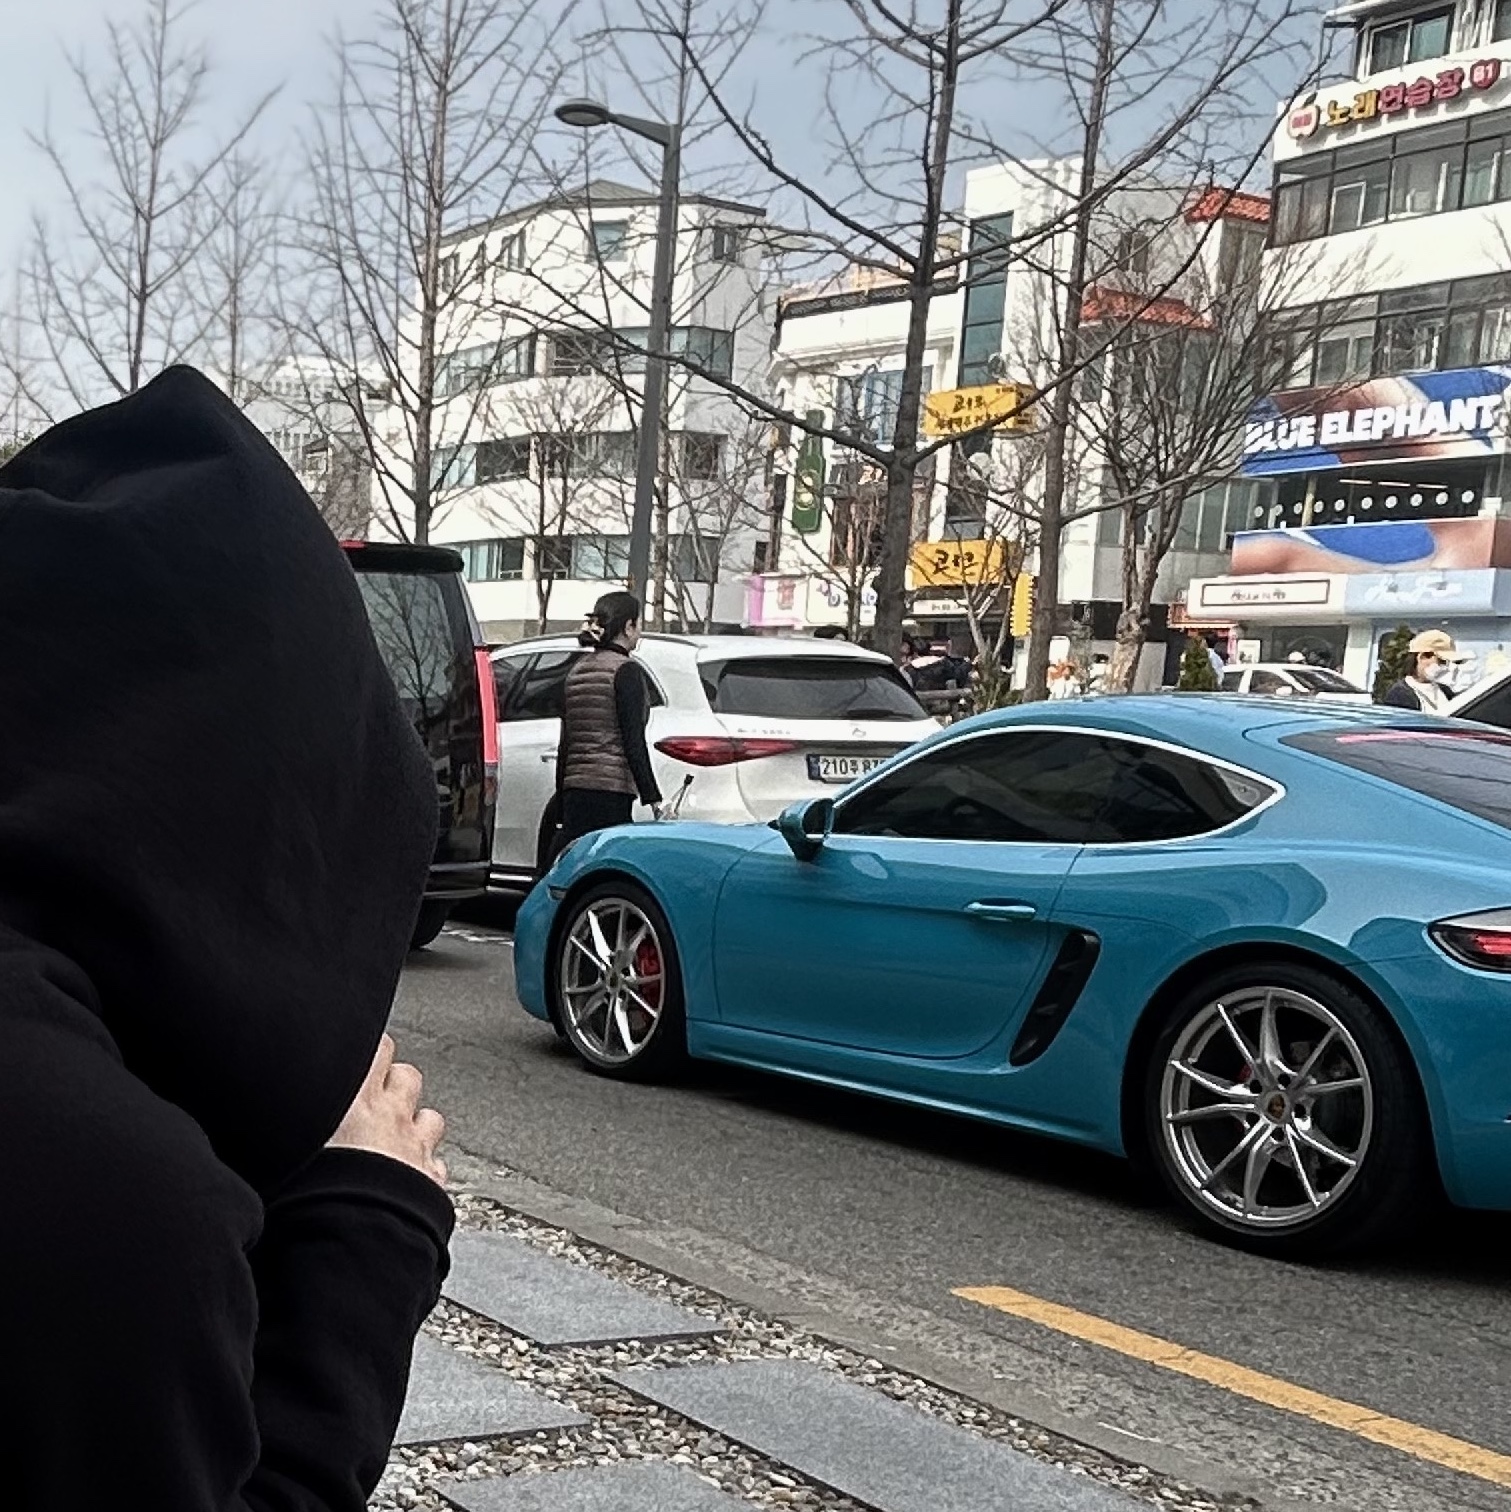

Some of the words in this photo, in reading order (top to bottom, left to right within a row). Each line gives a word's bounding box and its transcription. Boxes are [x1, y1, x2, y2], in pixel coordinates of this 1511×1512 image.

[1326, 67, 1465, 127] 노래연습장
[1244, 416, 1316, 454] BLUE
[1319, 395, 1503, 446] ELEPHANT
